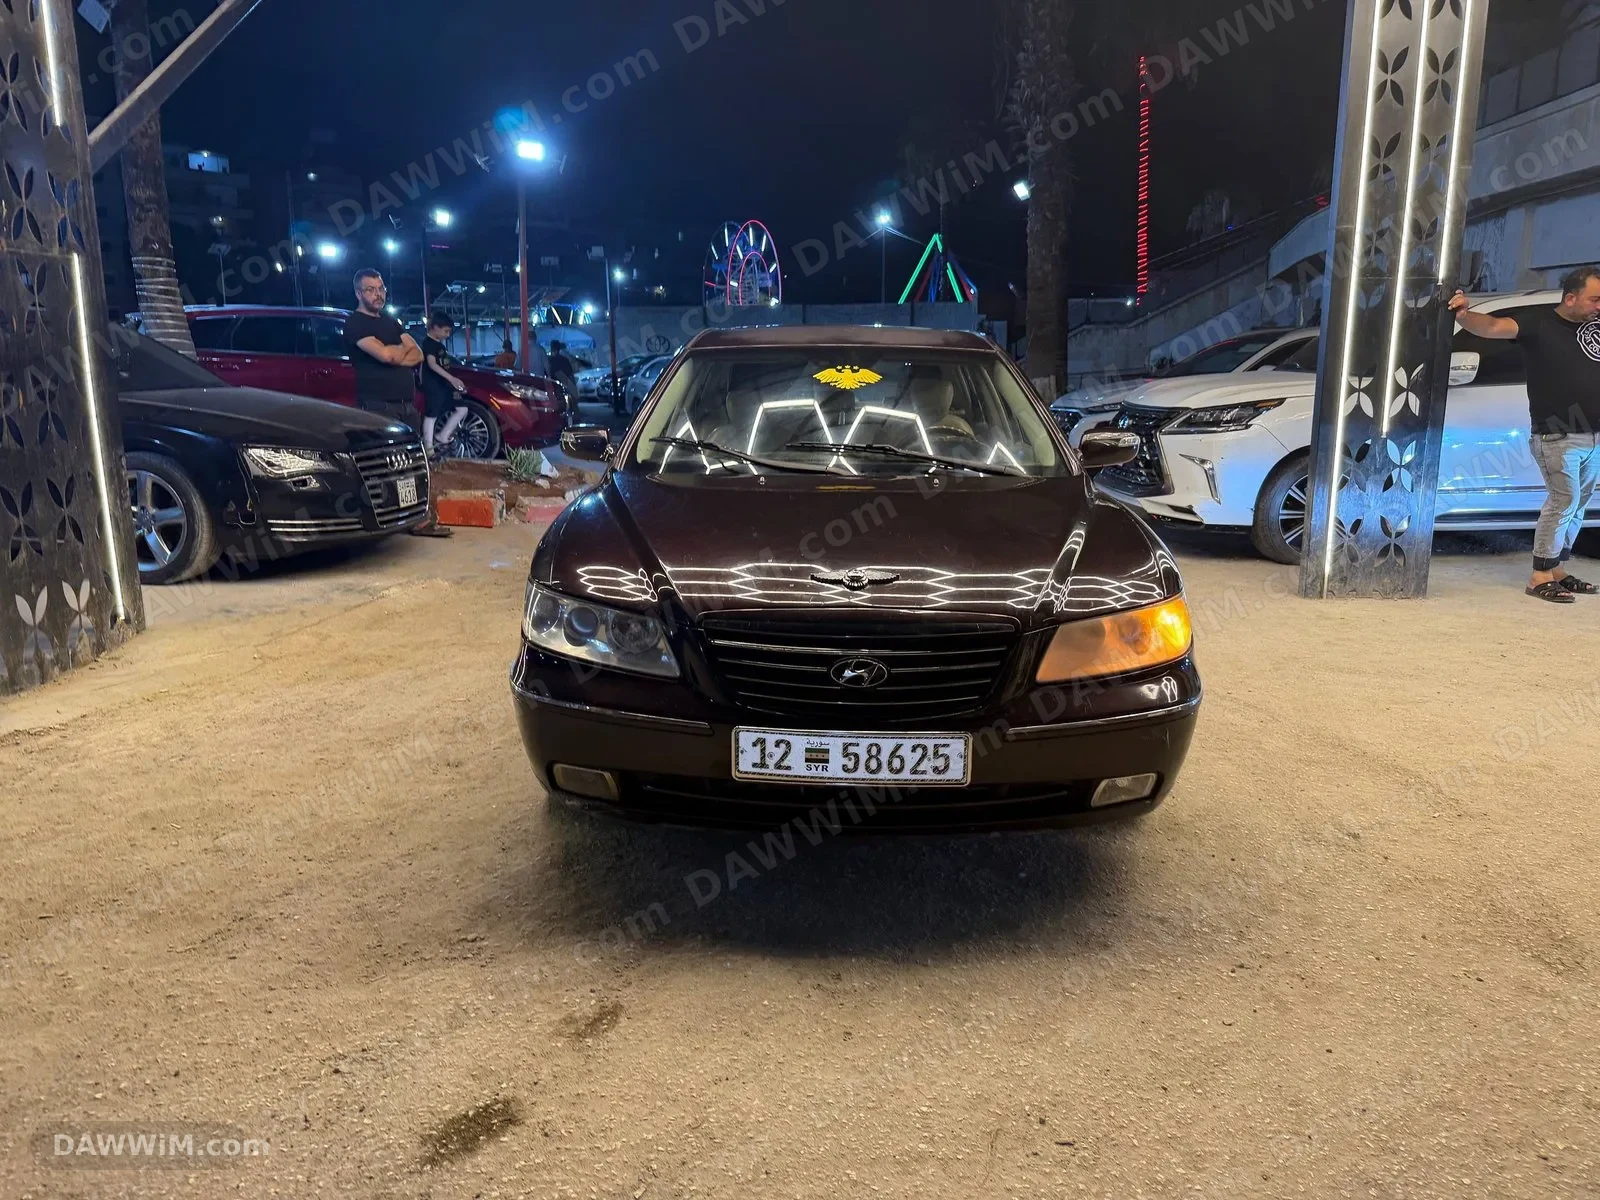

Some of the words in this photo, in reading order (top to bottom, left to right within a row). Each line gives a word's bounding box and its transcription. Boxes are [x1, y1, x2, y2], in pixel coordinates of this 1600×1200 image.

[751, 737, 792, 771] 12
[841, 742, 951, 775] 58625
[805, 764, 829, 772] SYR
